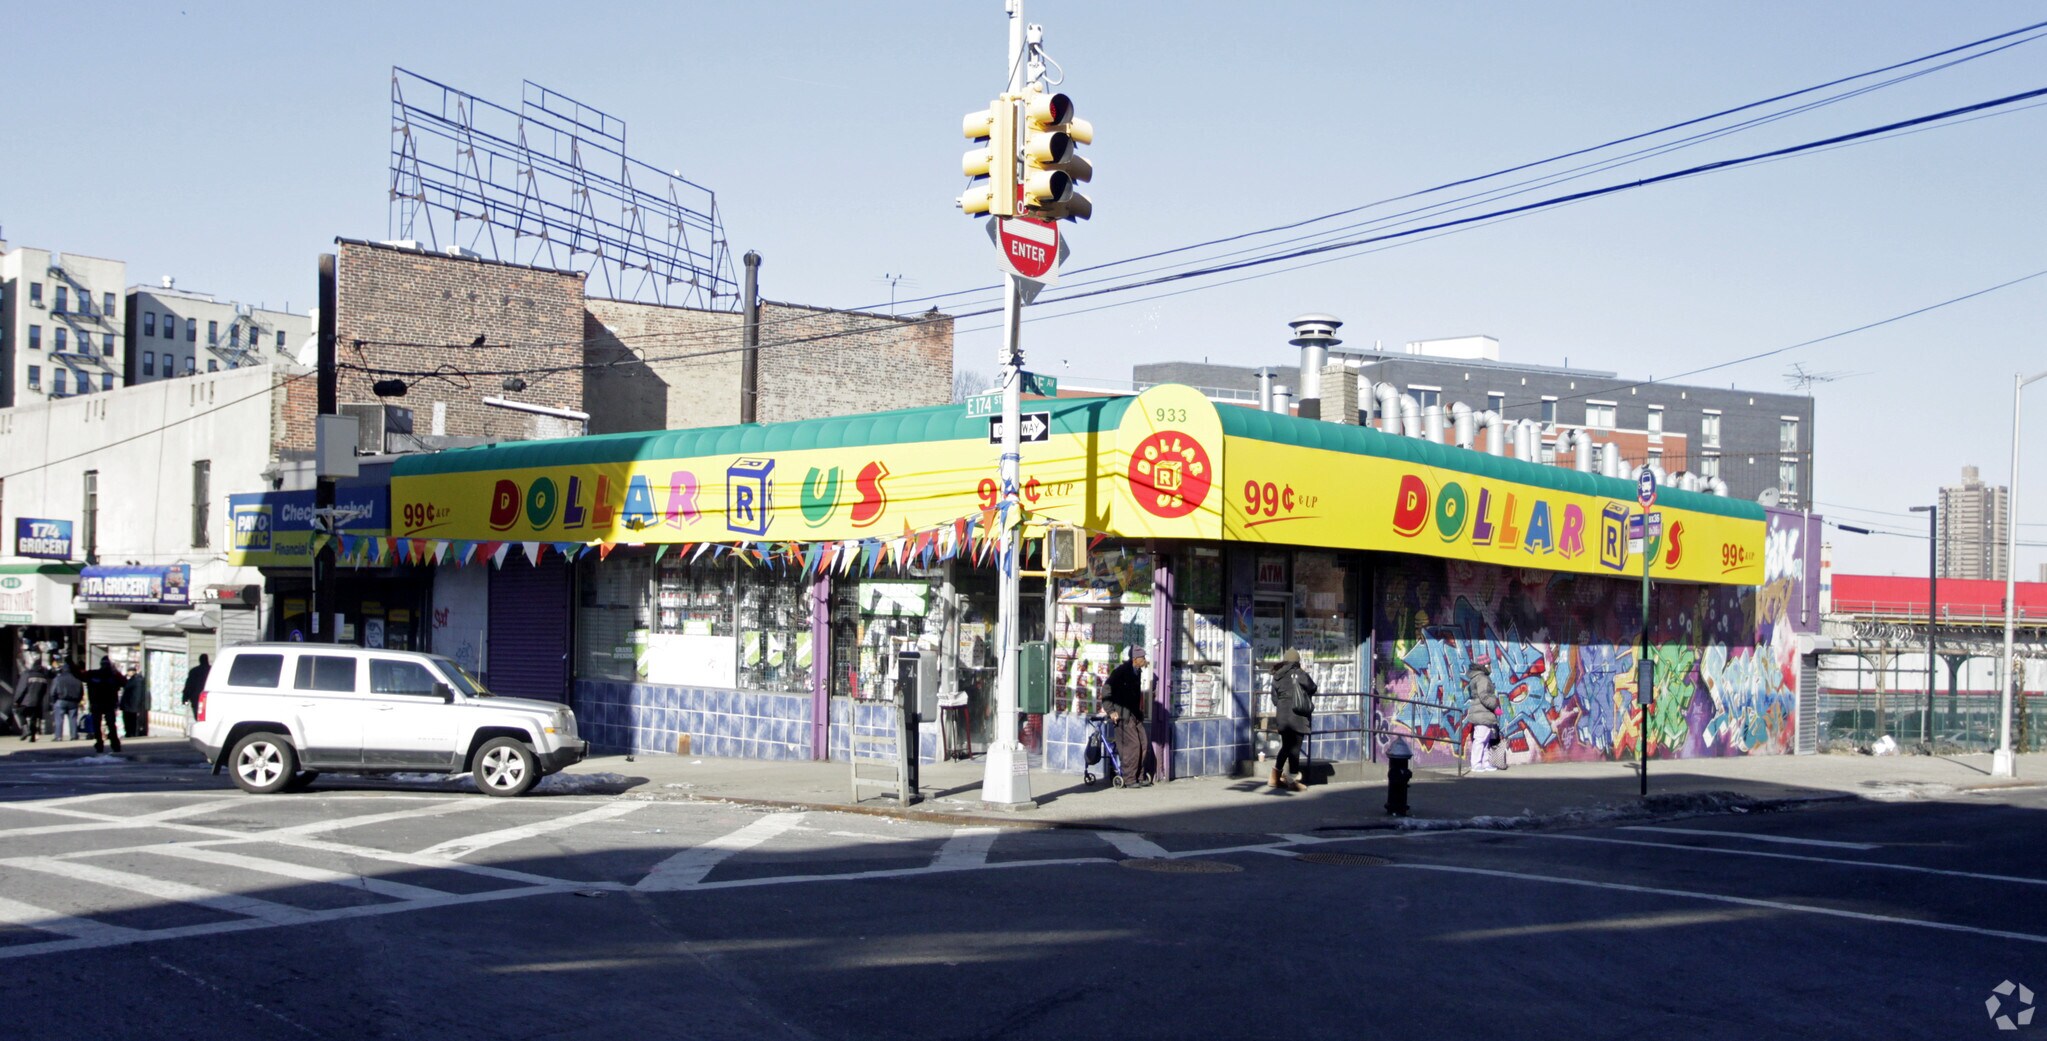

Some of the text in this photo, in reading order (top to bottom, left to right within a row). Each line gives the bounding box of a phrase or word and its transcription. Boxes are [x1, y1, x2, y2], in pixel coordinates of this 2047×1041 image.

[1011, 240, 1045, 263] ENTER
[1021, 374, 1055, 393] HOE AV
[967, 399, 974, 415] E
[976, 397, 992, 414] 174
[1156, 408, 1187, 423] 933
[1021, 423, 1040, 434] WAY
[1137, 438, 1203, 476] DOLLAR
[489, 470, 702, 532] DOLLAR
[800, 461, 890, 529] US
[978, 475, 1074, 511] 9¢ & UP
[1156, 494, 1183, 508] US
[1244, 480, 1295, 517] 99¢
[1305, 496, 1318, 508] UP
[404, 502, 435, 528] 99¢
[1393, 474, 1585, 560] DOLLAR
[30, 523, 61, 538] 174
[236, 531, 268, 546] MATIC
[19, 538, 70, 555] GROCERY
[275, 542, 308, 555] Financial
[1722, 542, 1744, 567] 99¢
[1259, 564, 1283, 583] ATM
[88, 576, 149, 596] 174 GROCERY
[163, 593, 186, 601] GROCERY
